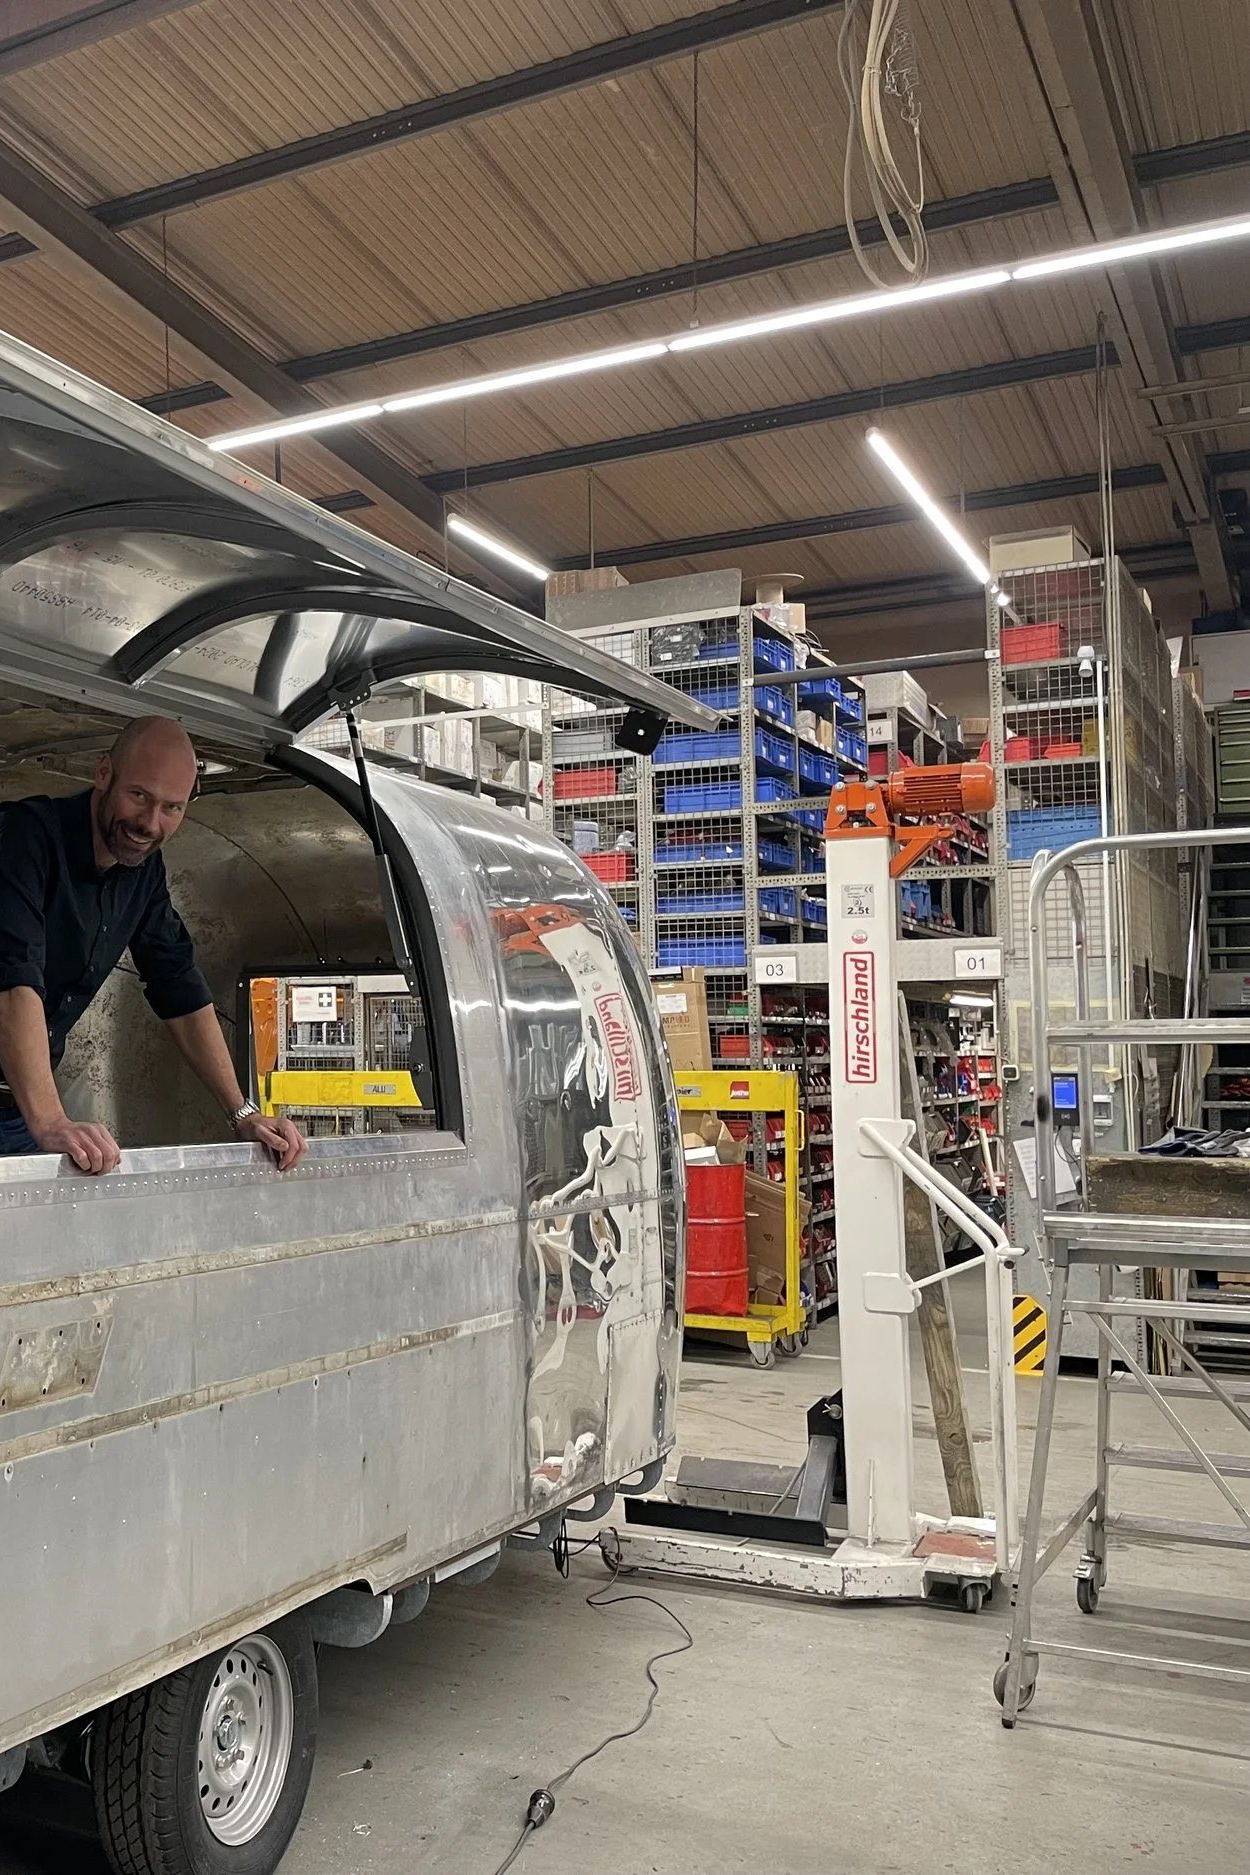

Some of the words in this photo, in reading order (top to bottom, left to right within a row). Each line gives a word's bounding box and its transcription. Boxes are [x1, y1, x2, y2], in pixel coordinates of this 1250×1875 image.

[869, 726, 882, 737] 14
[847, 907, 869, 915] 2.5t
[966, 957, 986, 970] 01
[765, 964, 784, 976] 03
[850, 957, 871, 1078] hirschland
[371, 1084, 386, 1094] ALU
